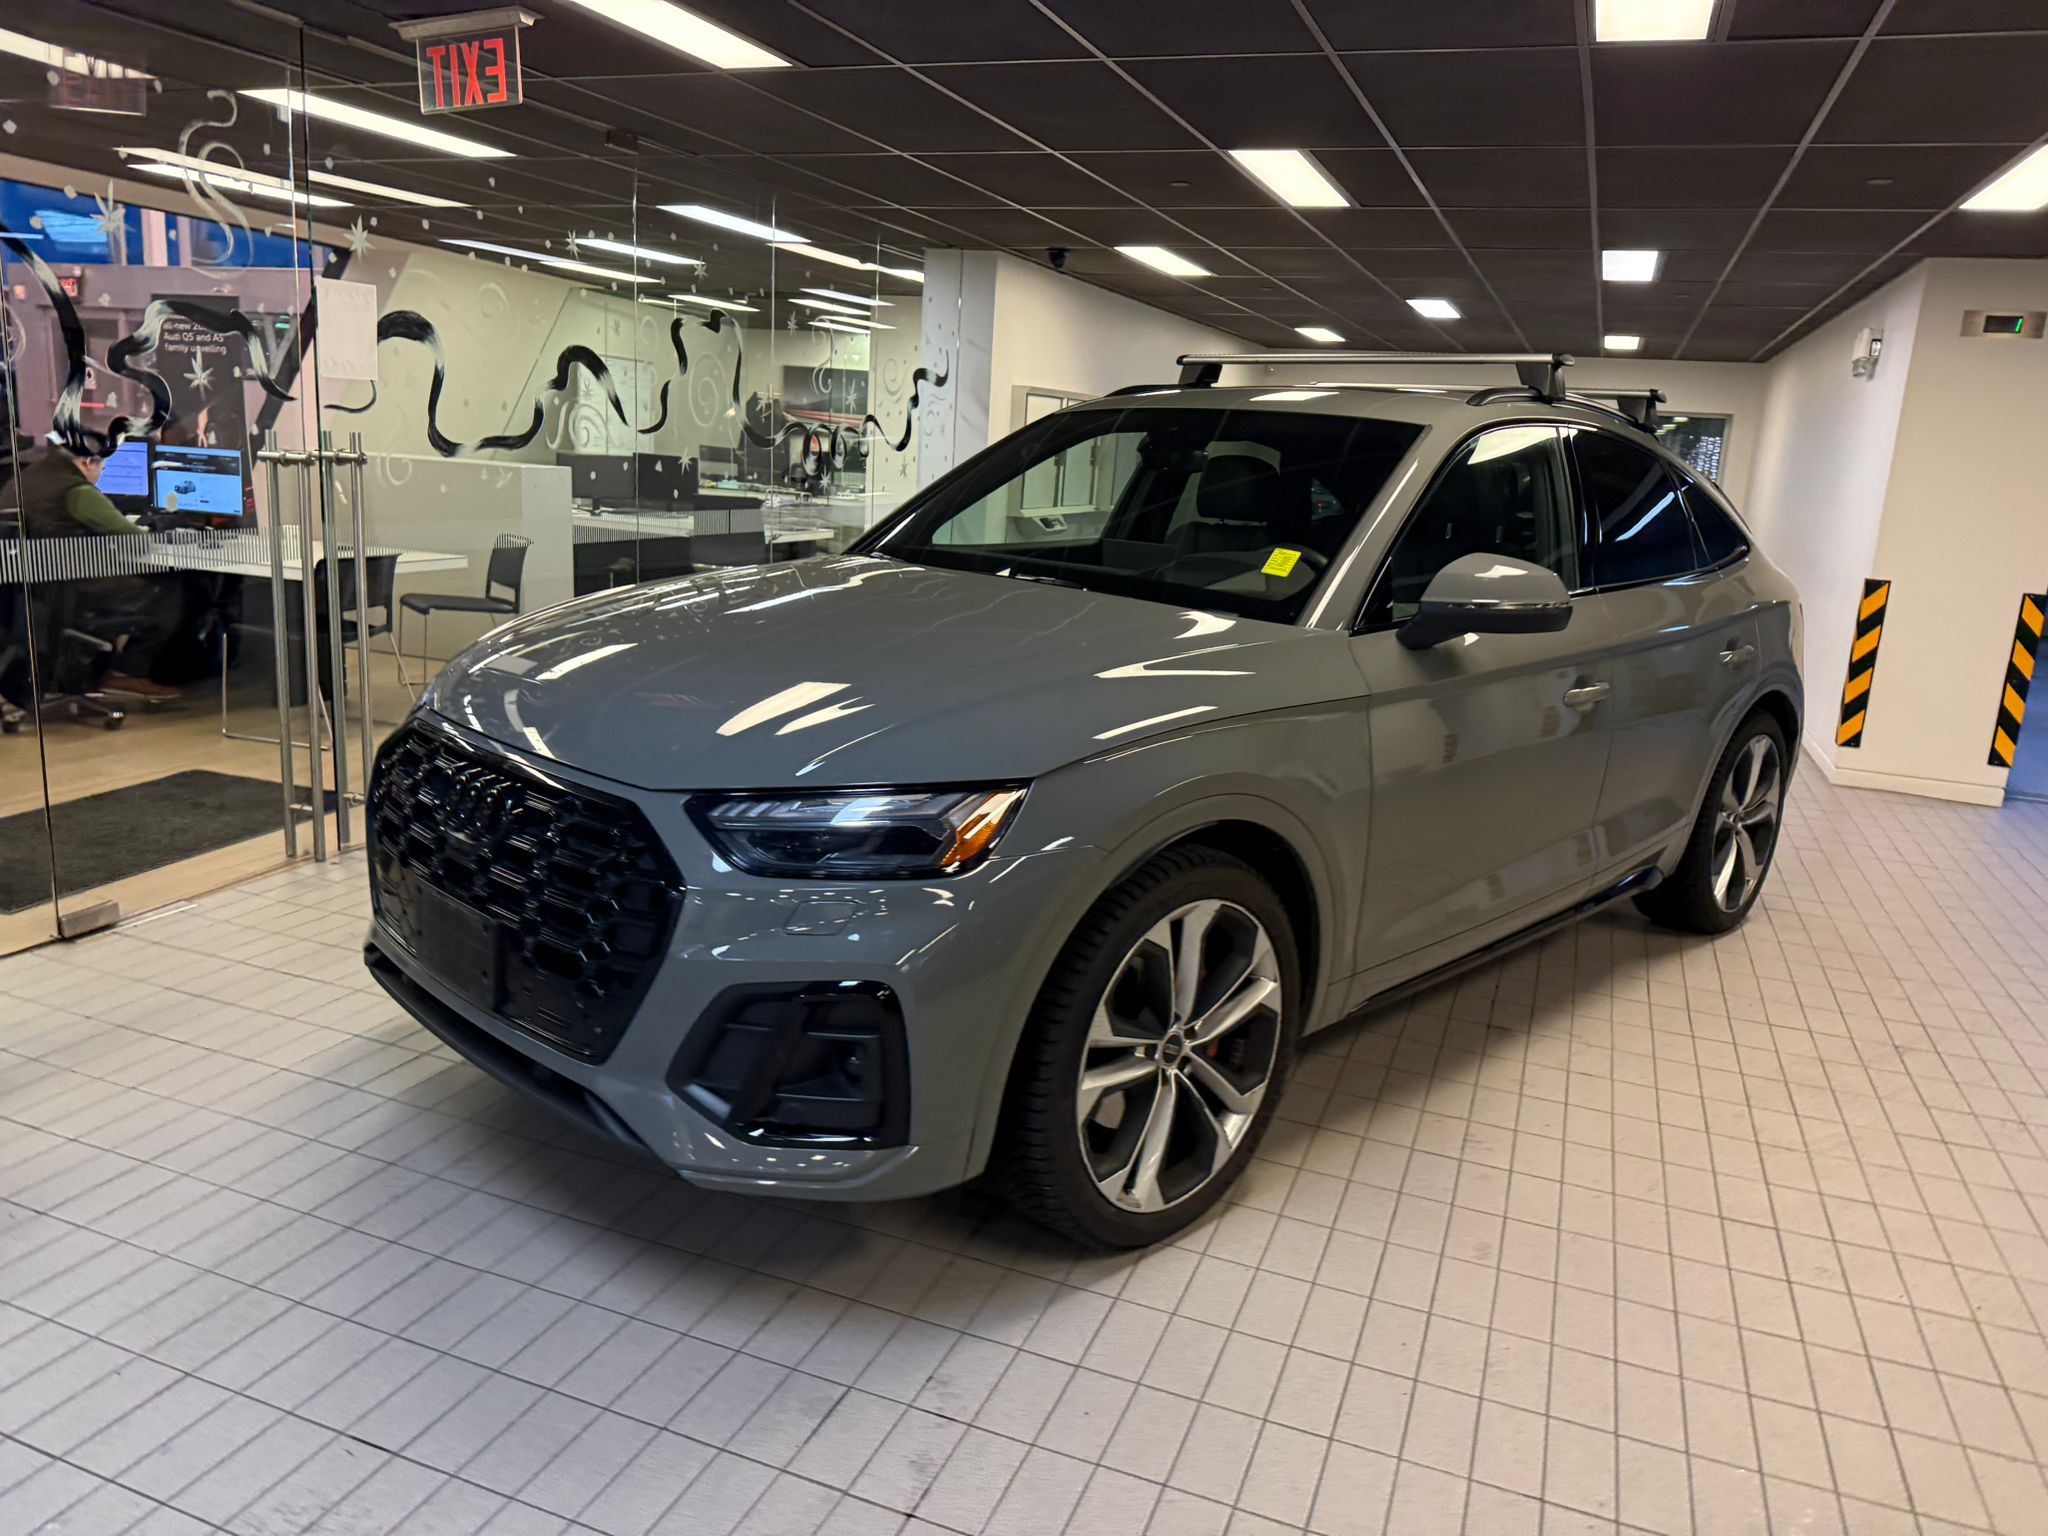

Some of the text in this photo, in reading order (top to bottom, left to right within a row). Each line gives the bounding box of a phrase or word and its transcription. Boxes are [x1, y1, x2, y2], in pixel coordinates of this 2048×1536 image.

[164, 332, 224, 342] Audi Q5 and A5
[165, 342, 189, 353] family
